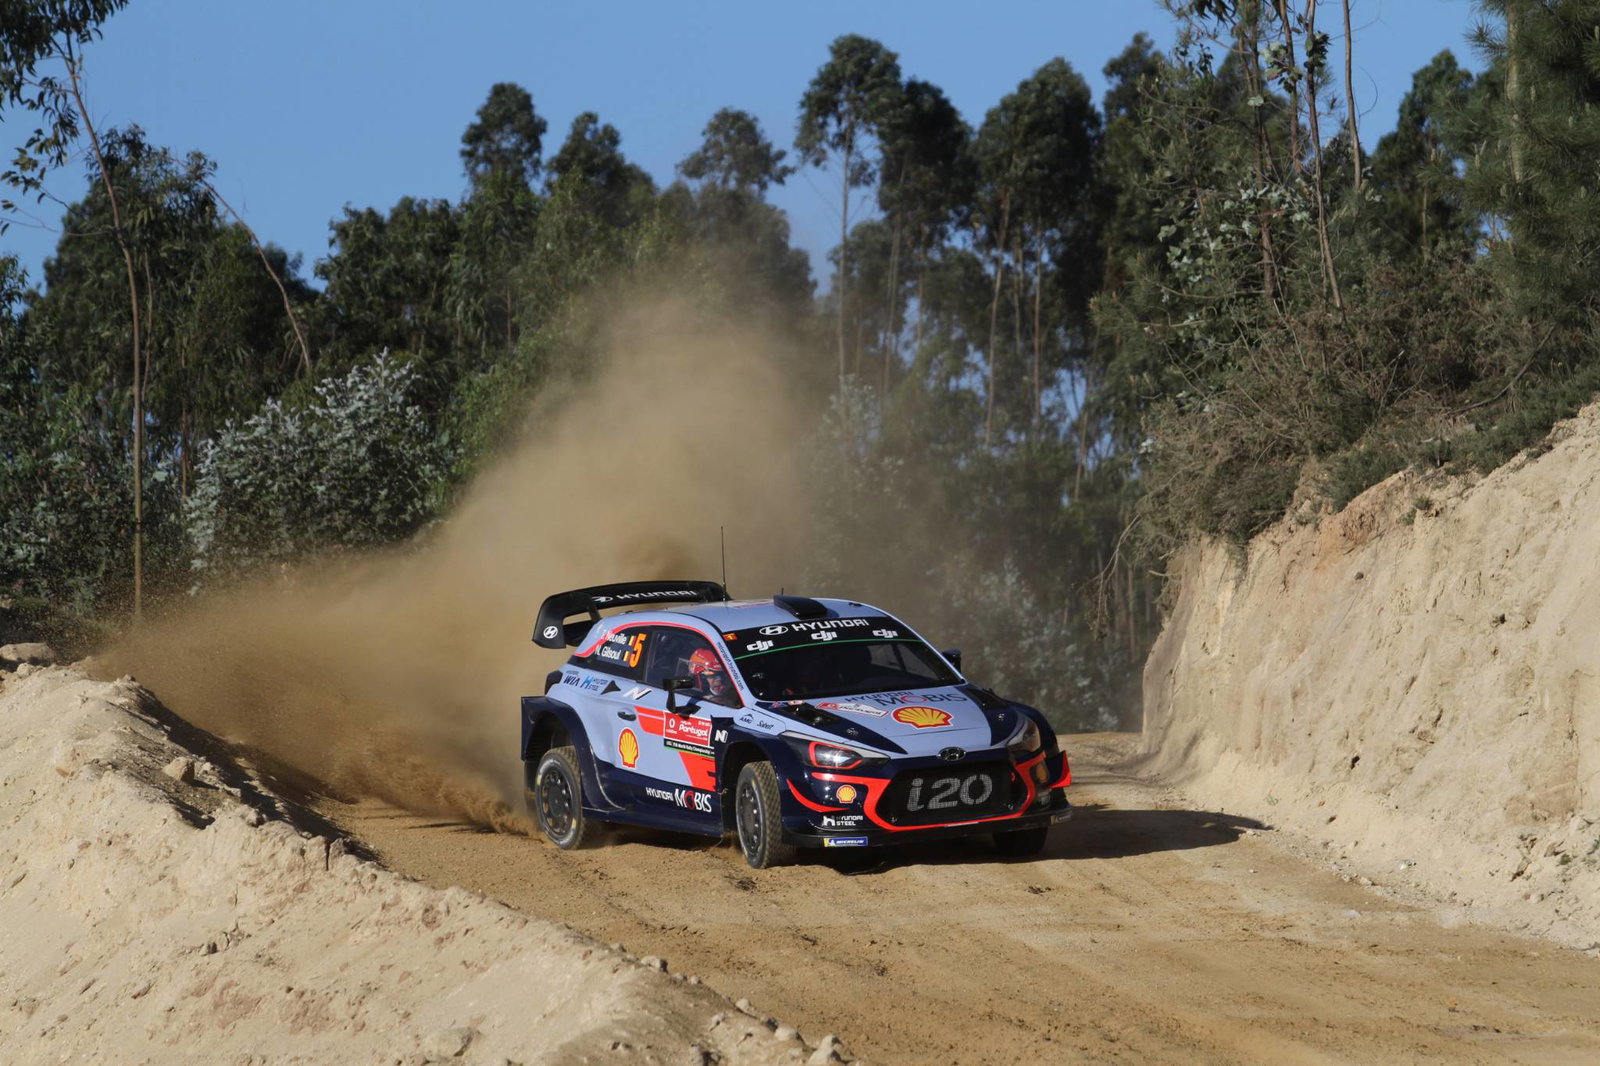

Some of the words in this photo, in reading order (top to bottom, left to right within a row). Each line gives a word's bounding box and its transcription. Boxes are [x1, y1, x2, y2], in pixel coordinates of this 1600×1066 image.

[616, 590, 697, 599] HYUNDAI
[792, 619, 870, 631] HYUNDAI
[606, 631, 627, 645] Neuville
[601, 646, 622, 660] Gilsoul
[629, 633, 647, 667] 5
[563, 675, 580, 687] WIA
[844, 691, 914, 702] HYUNDAI
[876, 693, 969, 706] MOBIS
[679, 723, 708, 736] Portugal
[907, 774, 993, 811] i20
[646, 787, 675, 801] HYUNDAI
[674, 788, 712, 813] MOBIS
